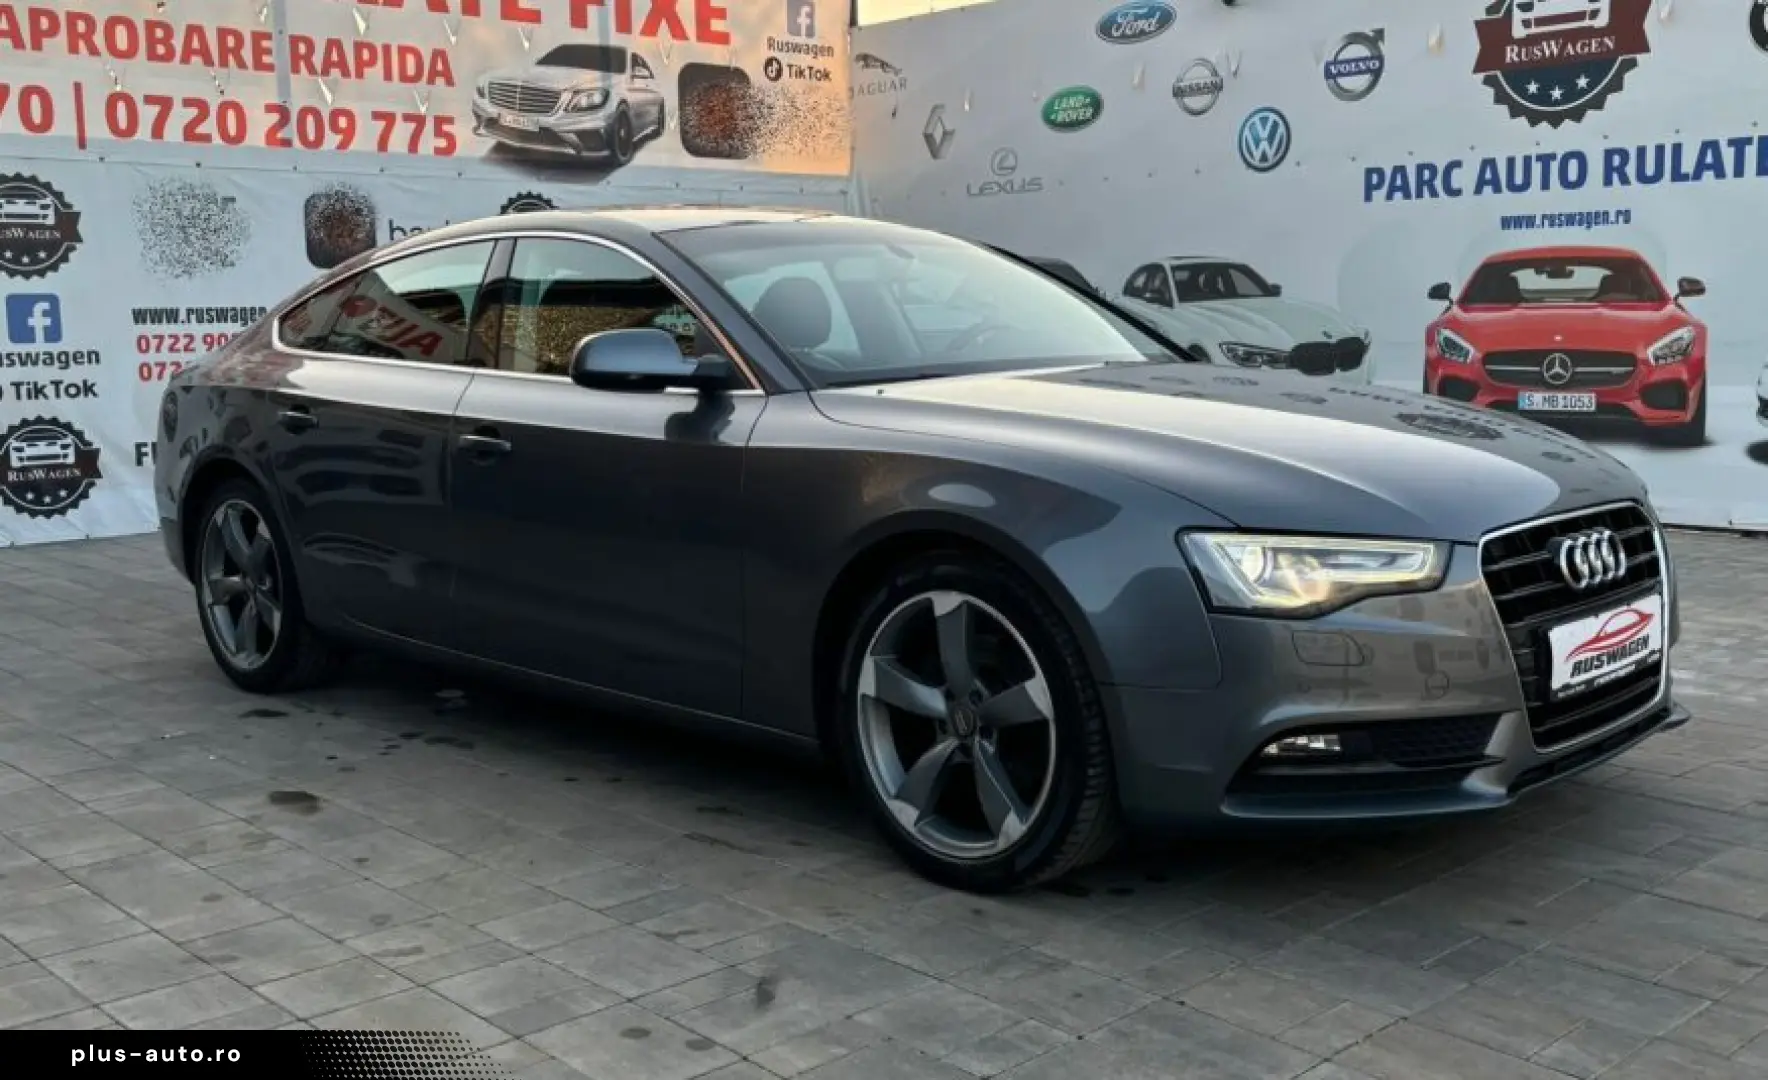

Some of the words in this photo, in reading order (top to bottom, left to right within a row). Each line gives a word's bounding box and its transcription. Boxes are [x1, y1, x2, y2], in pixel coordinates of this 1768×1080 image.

[1111, 11, 1161, 37] Ford
[0, 4, 275, 71] APROBARE
[290, 34, 455, 87] RAPIDA
[767, 36, 834, 58] Ruswagen
[787, 64, 832, 82] TikTok
[1330, 60, 1379, 74] VOLVO
[1054, 95, 1091, 110] LAND
[104, 90, 248, 146] 0720
[264, 103, 356, 150] 209
[371, 111, 457, 156] 775
[1056, 107, 1093, 123] ROVER
[1364, 160, 1463, 202] PARC
[1474, 150, 1587, 196] AUTO
[966, 177, 1043, 197] LEXUS
[1500, 209, 1631, 230] www.ruswagen.ro
[137, 333, 195, 353] 0722
[202, 333, 240, 352] 90
[0, 349, 100, 370] swagen
[10, 379, 98, 401] TikTok
[1569, 633, 1650, 678] RUSWAGEN
